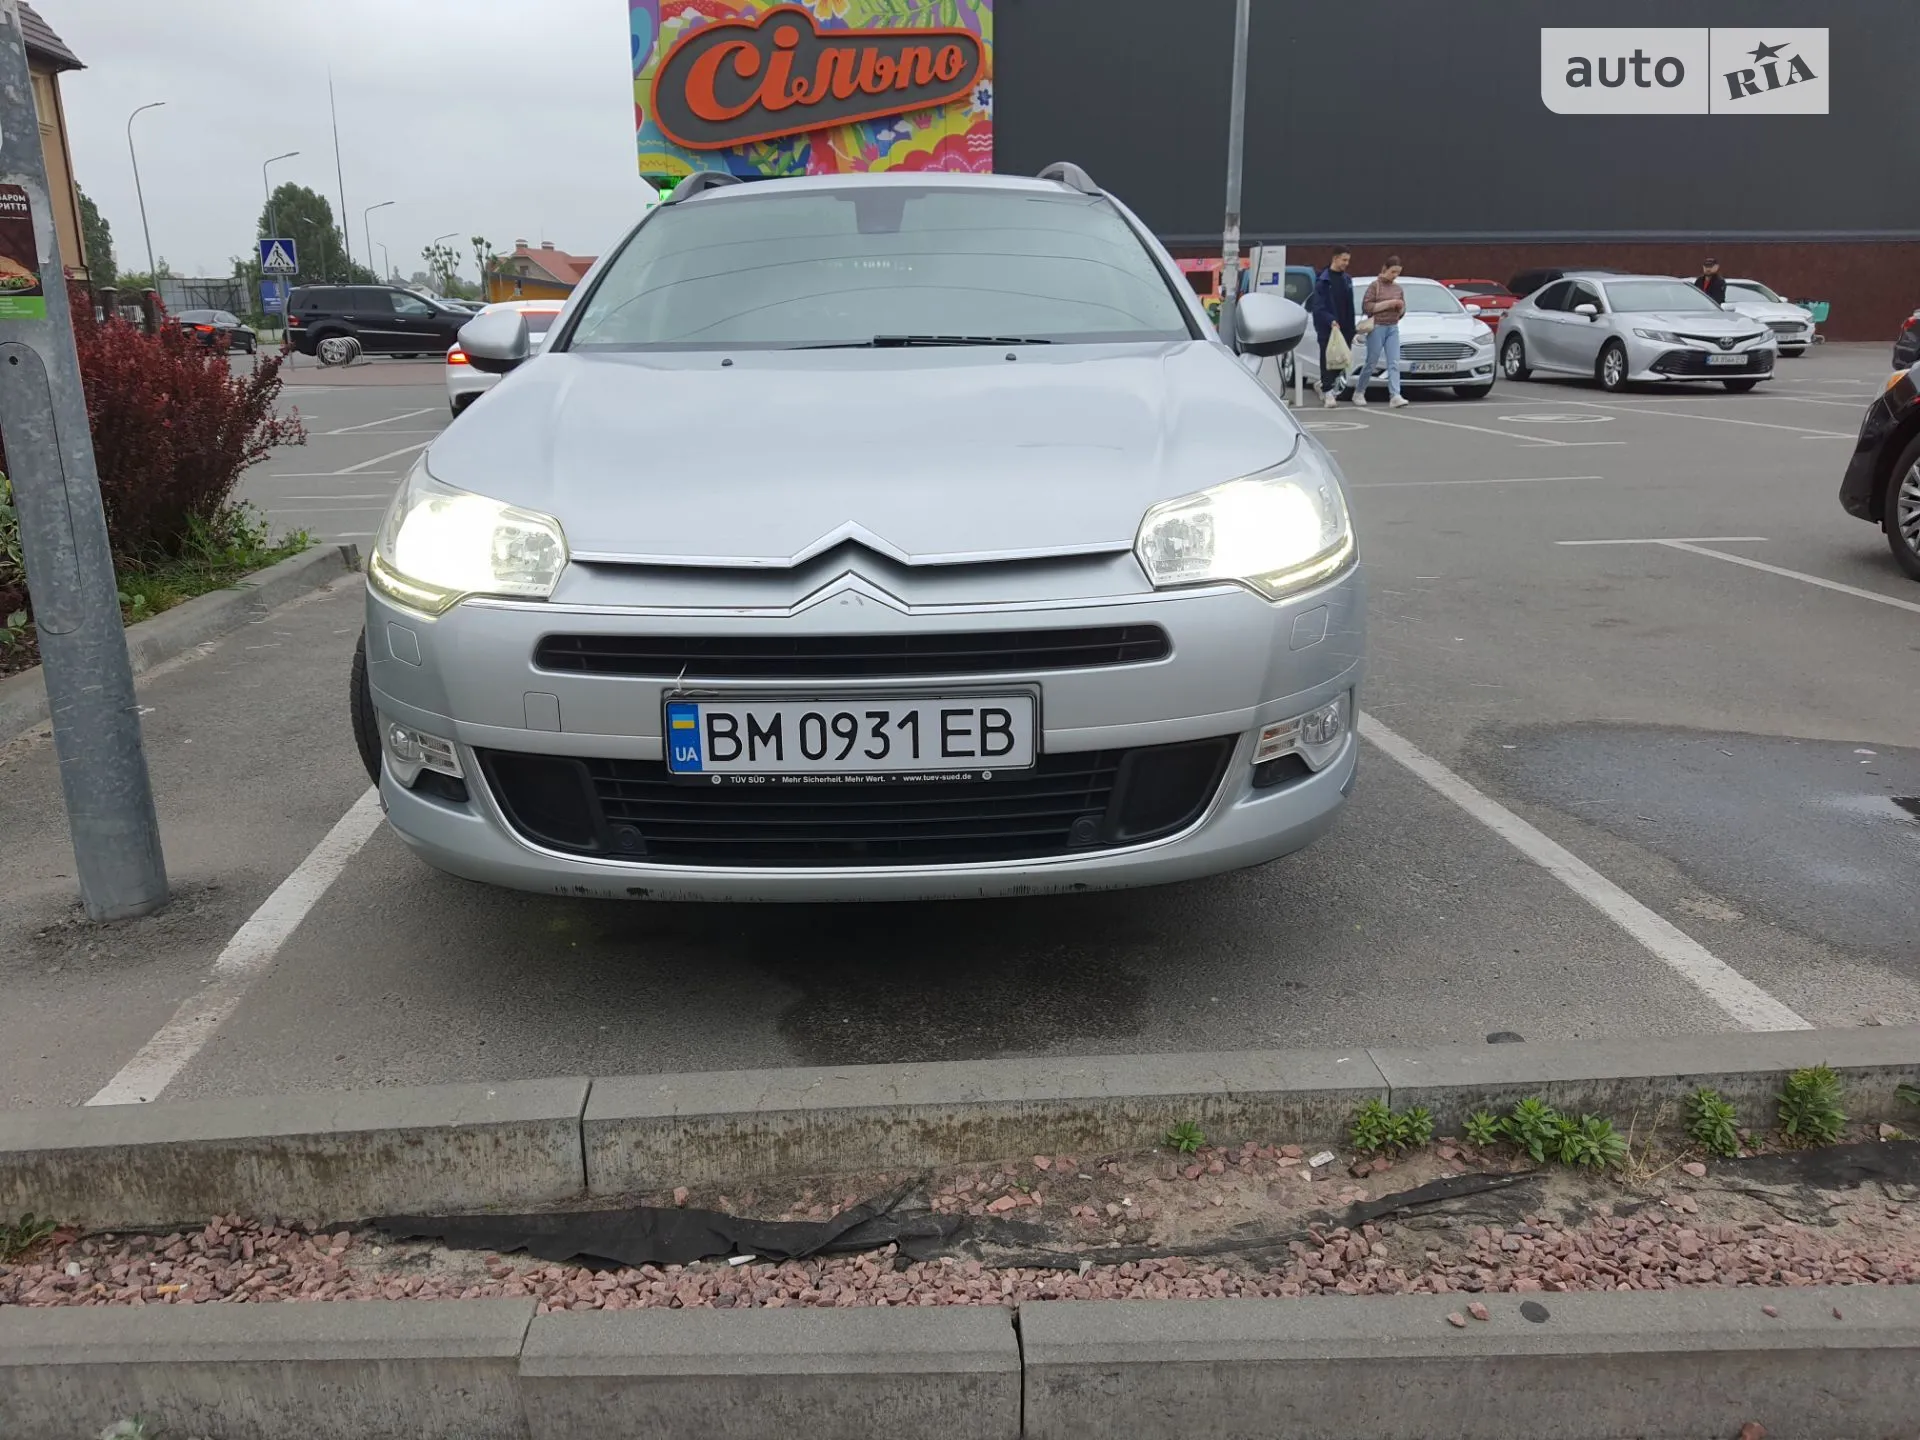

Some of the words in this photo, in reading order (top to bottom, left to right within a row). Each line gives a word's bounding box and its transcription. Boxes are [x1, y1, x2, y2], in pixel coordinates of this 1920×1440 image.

[685, 26, 967, 120] Сільпо
[675, 747, 699, 762] UA
[706, 712, 783, 761] BM
[799, 711, 919, 761] 0931
[941, 708, 1015, 758] EB
[730, 775, 746, 784] TÜV
[748, 775, 765, 784] SÜD
[803, 775, 843, 783] Sicherheit.
[865, 775, 886, 783] Wert.
[903, 773, 972, 782] www.tuev-sued.de
